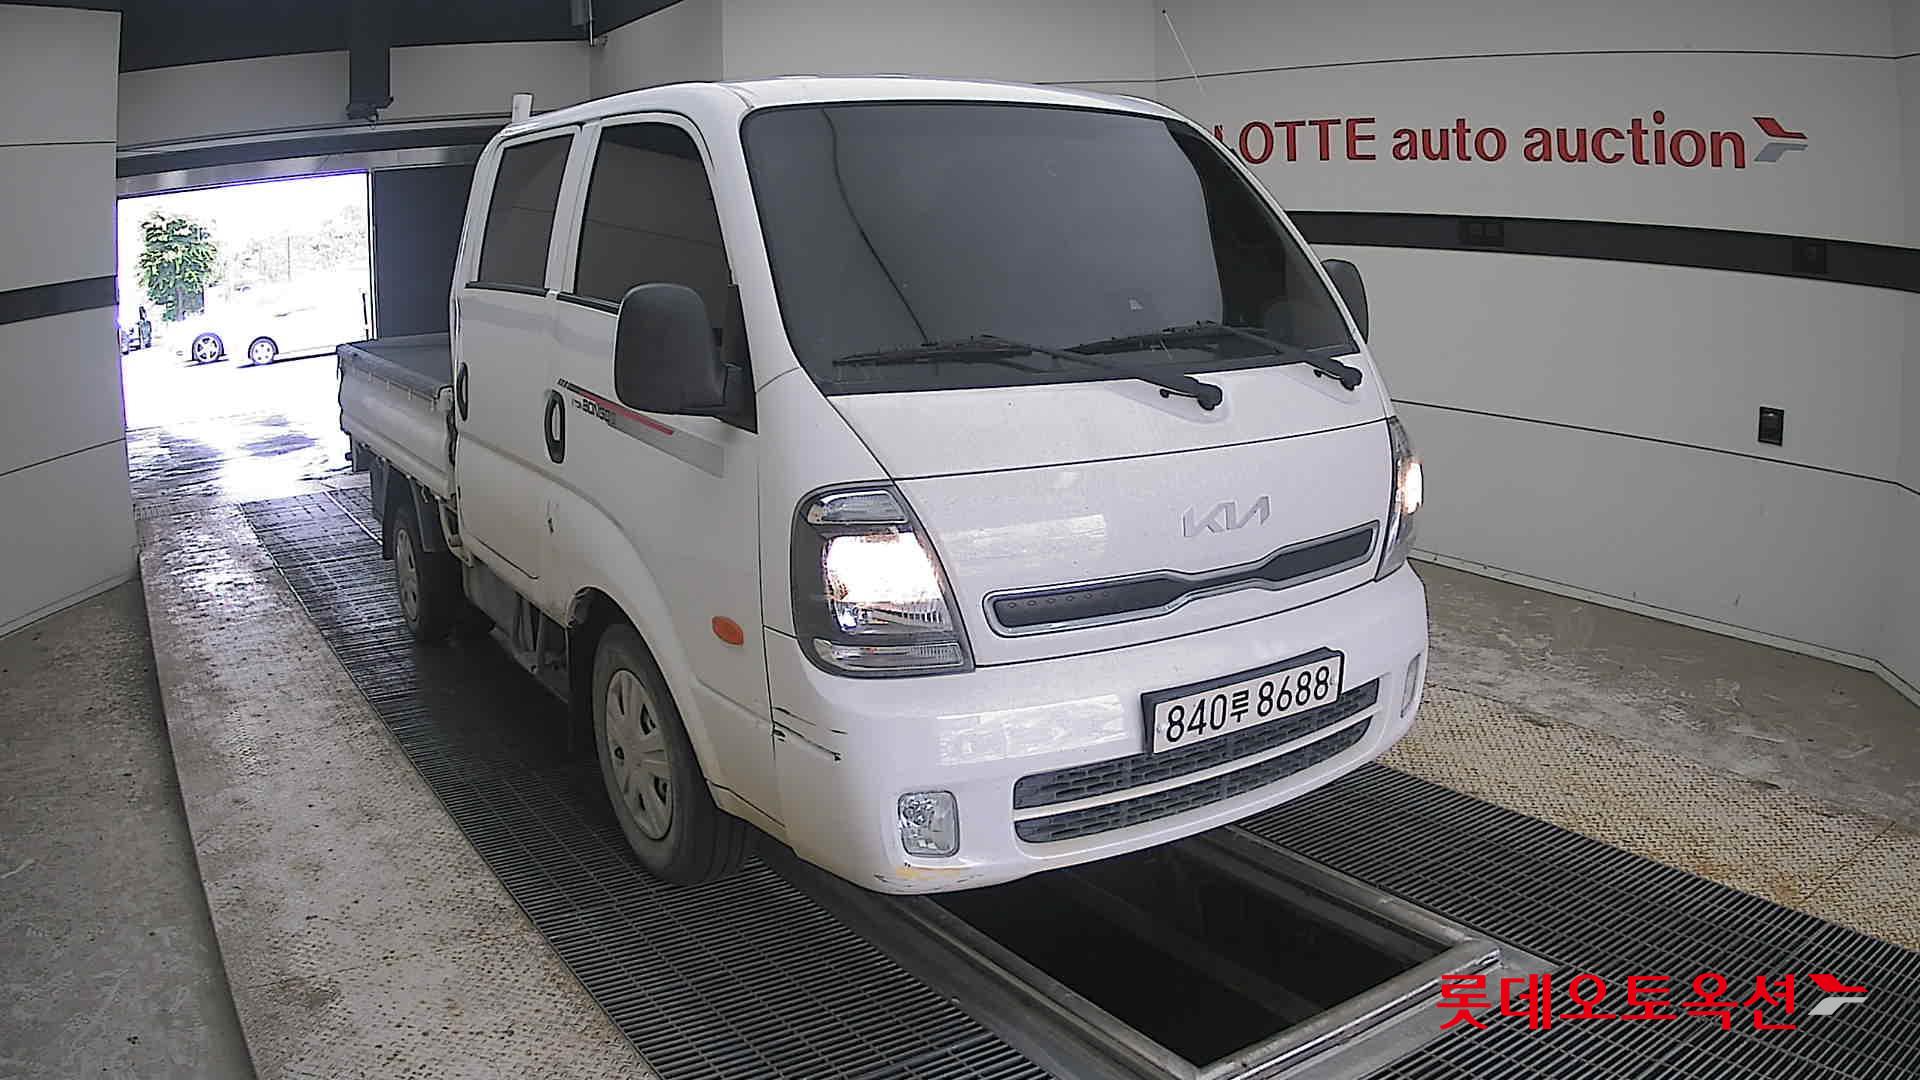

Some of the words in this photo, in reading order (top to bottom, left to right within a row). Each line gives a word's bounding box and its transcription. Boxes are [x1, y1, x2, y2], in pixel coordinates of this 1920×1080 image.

[1392, 118, 1507, 162] auto
[1523, 110, 1746, 169] auction
[1181, 496, 1271, 538] KIA
[1166, 689, 1249, 742] 840루
[1257, 666, 1330, 717] 8688
